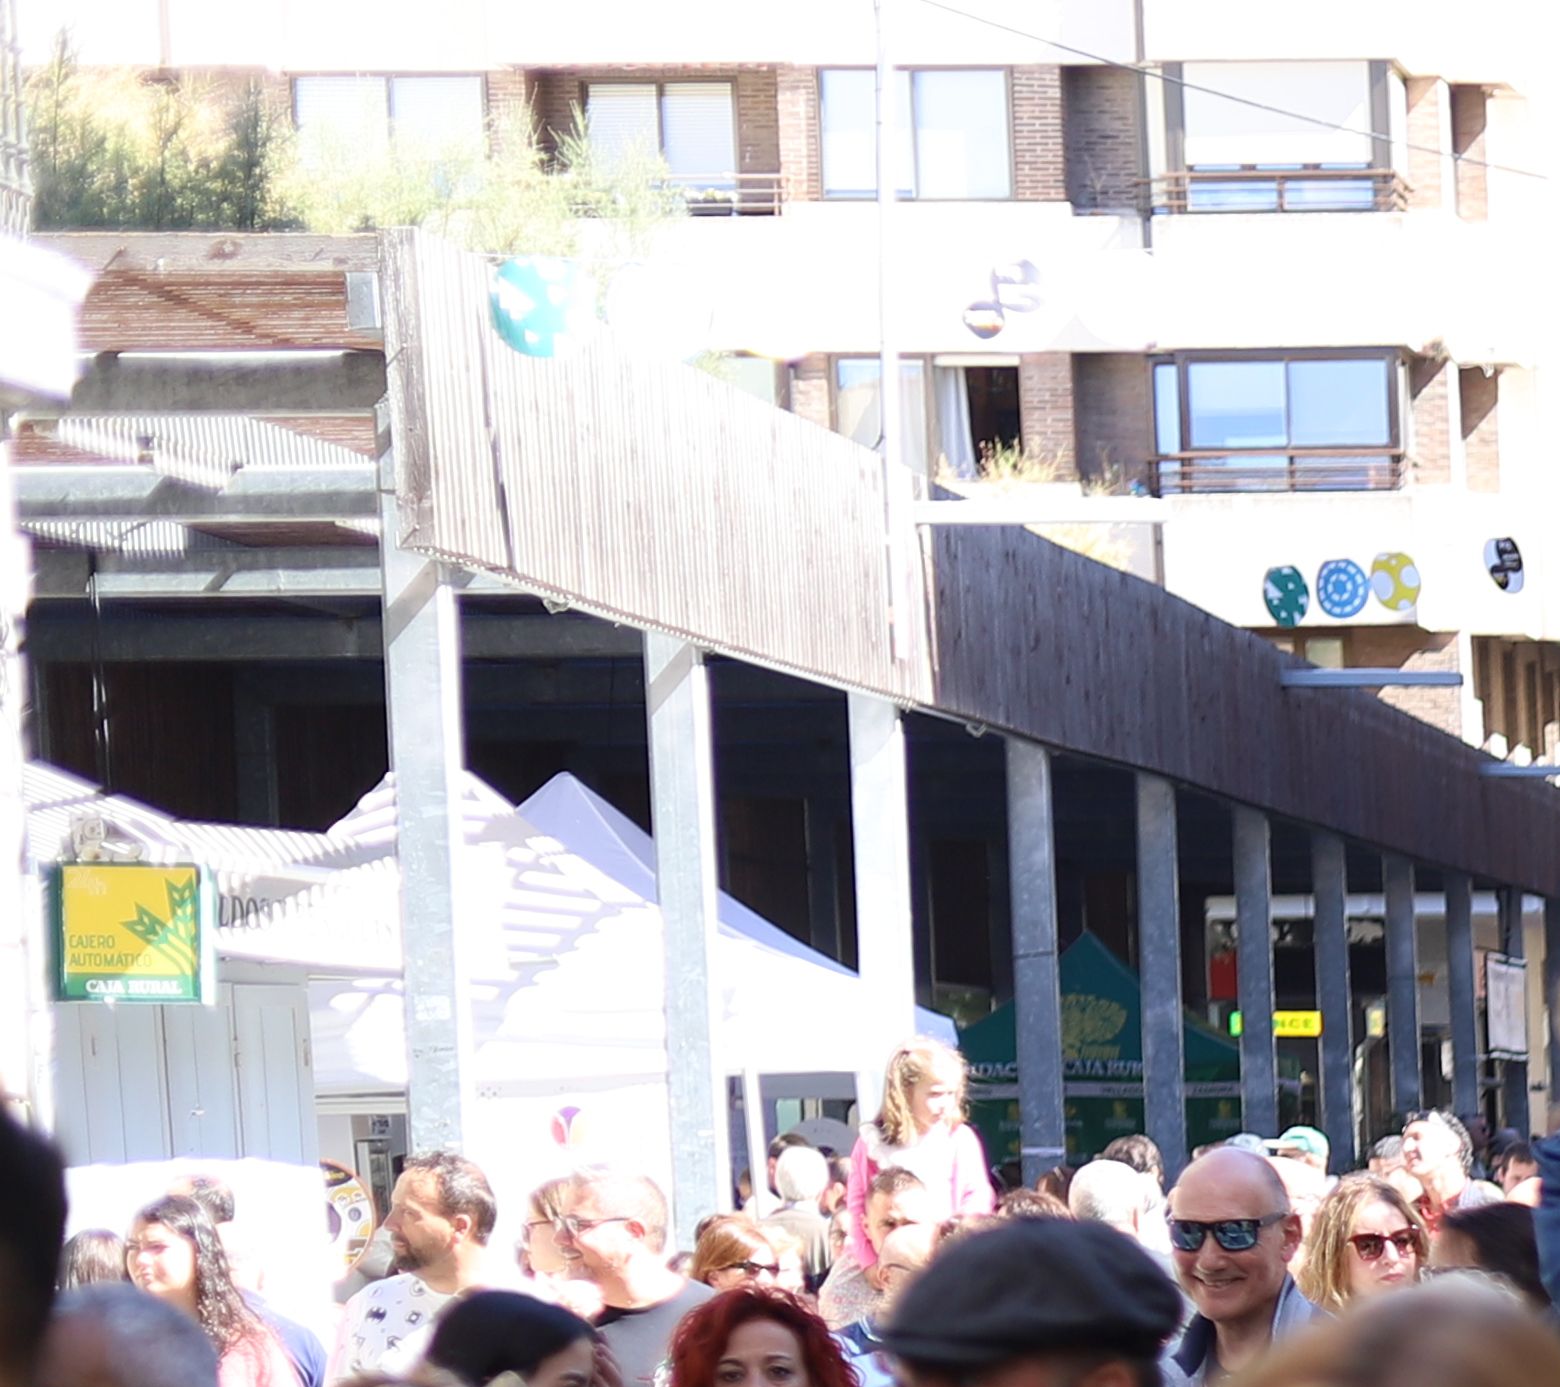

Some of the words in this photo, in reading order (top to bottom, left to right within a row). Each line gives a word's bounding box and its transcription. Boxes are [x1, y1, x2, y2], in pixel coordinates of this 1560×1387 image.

[69, 934, 116, 950] CAJERO
[69, 951, 152, 968] AUTOMÁTICO
[86, 980, 126, 994] CAJA
[127, 980, 182, 995] RURAL
